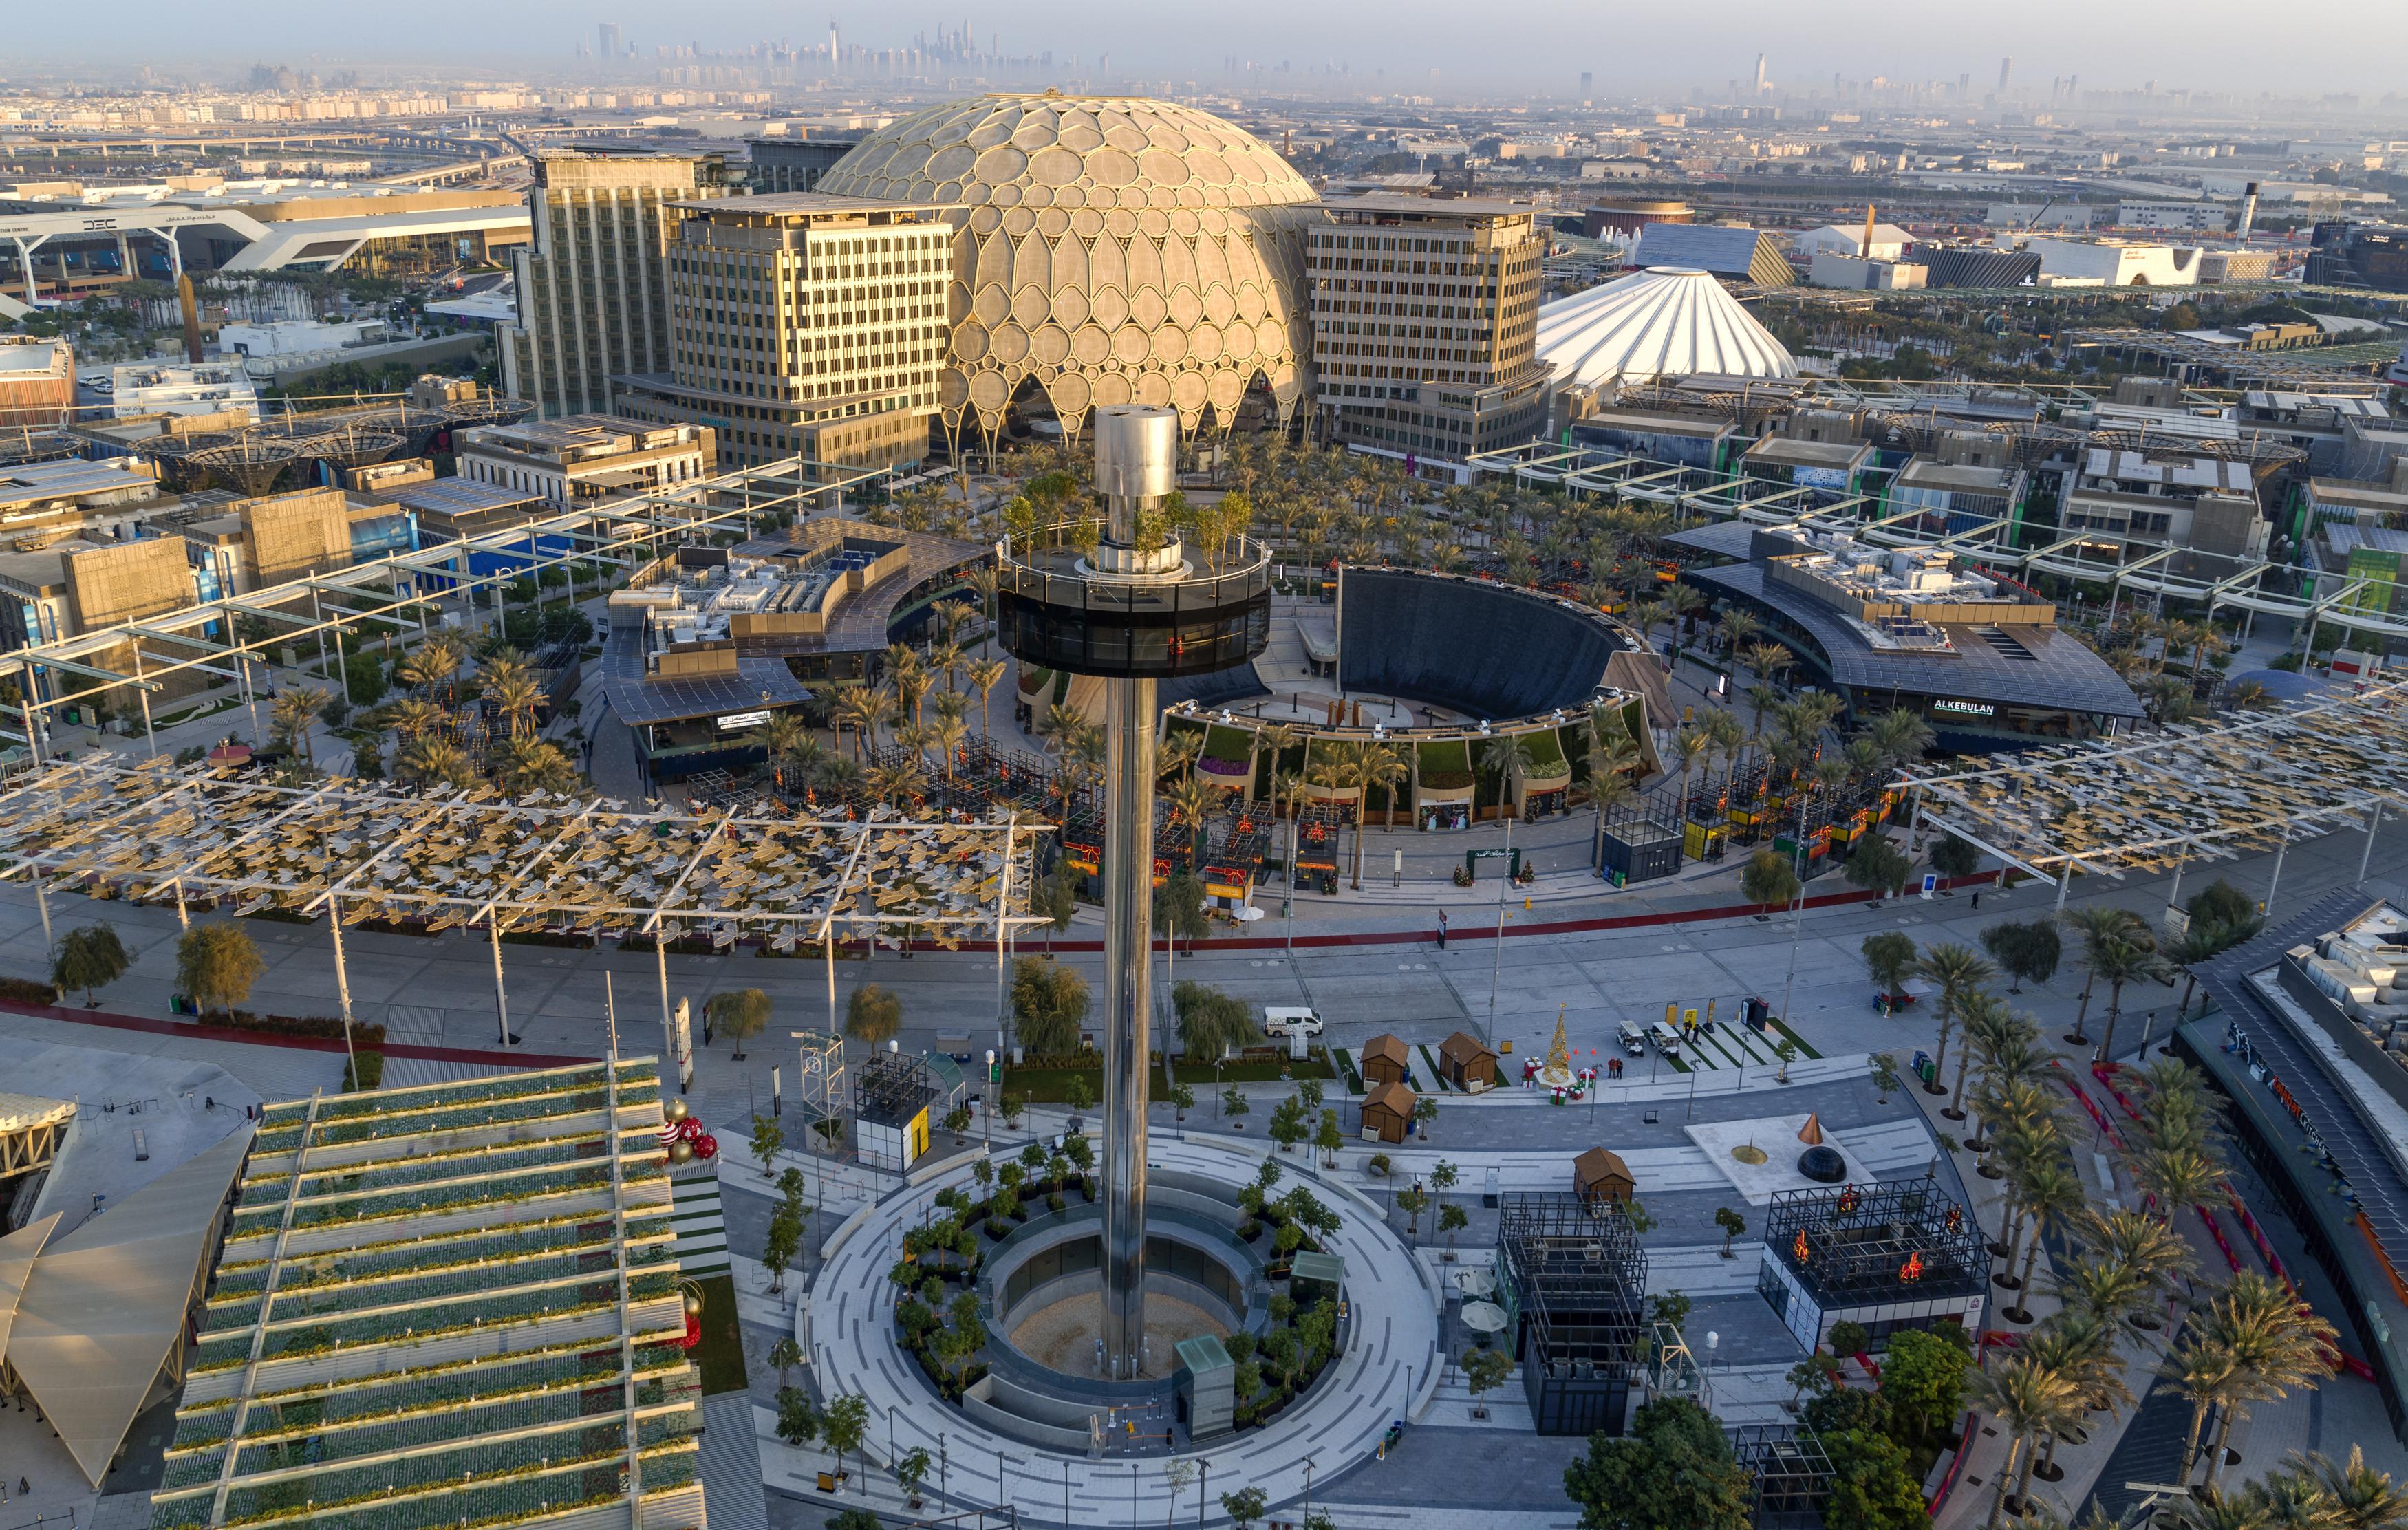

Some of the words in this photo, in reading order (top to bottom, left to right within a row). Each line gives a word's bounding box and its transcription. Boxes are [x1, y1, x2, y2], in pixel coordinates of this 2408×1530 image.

[1935, 700, 1994, 713] ALKEBULAN
[2272, 1075, 2301, 1119] talabat
[2303, 1119, 2327, 1155] KITCHEN
